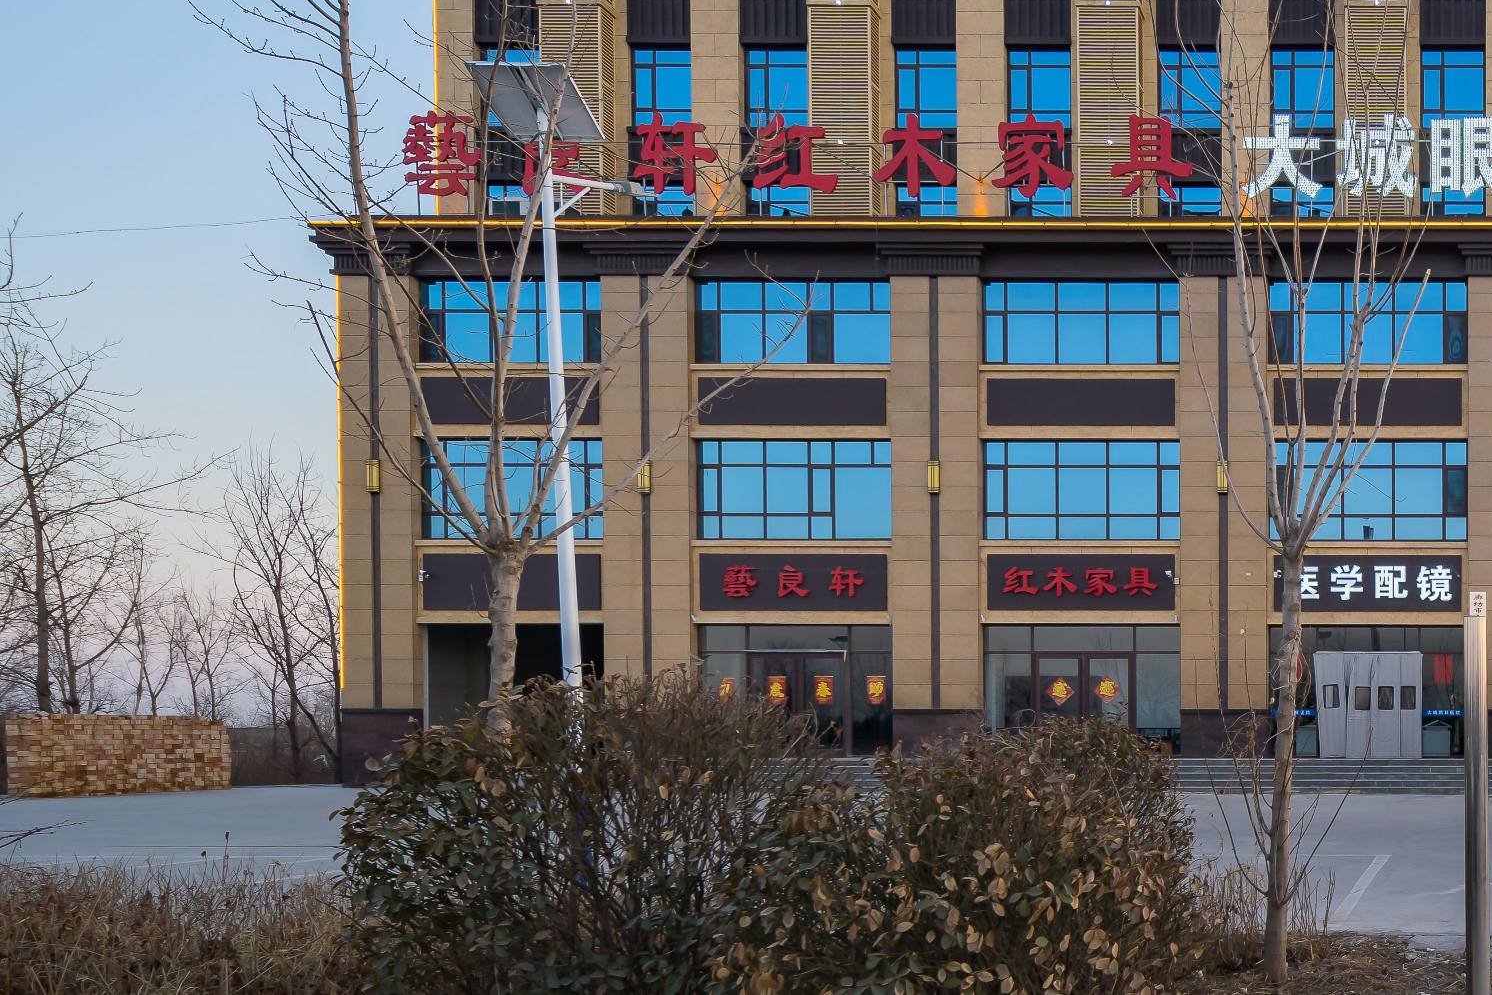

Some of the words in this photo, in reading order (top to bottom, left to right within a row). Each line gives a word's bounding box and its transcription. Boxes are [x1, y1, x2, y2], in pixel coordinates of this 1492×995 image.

[721, 564, 864, 598] 藝良轩
[1002, 566, 1158, 597] 红木家具
[1300, 564, 1453, 601] 医学配镜
